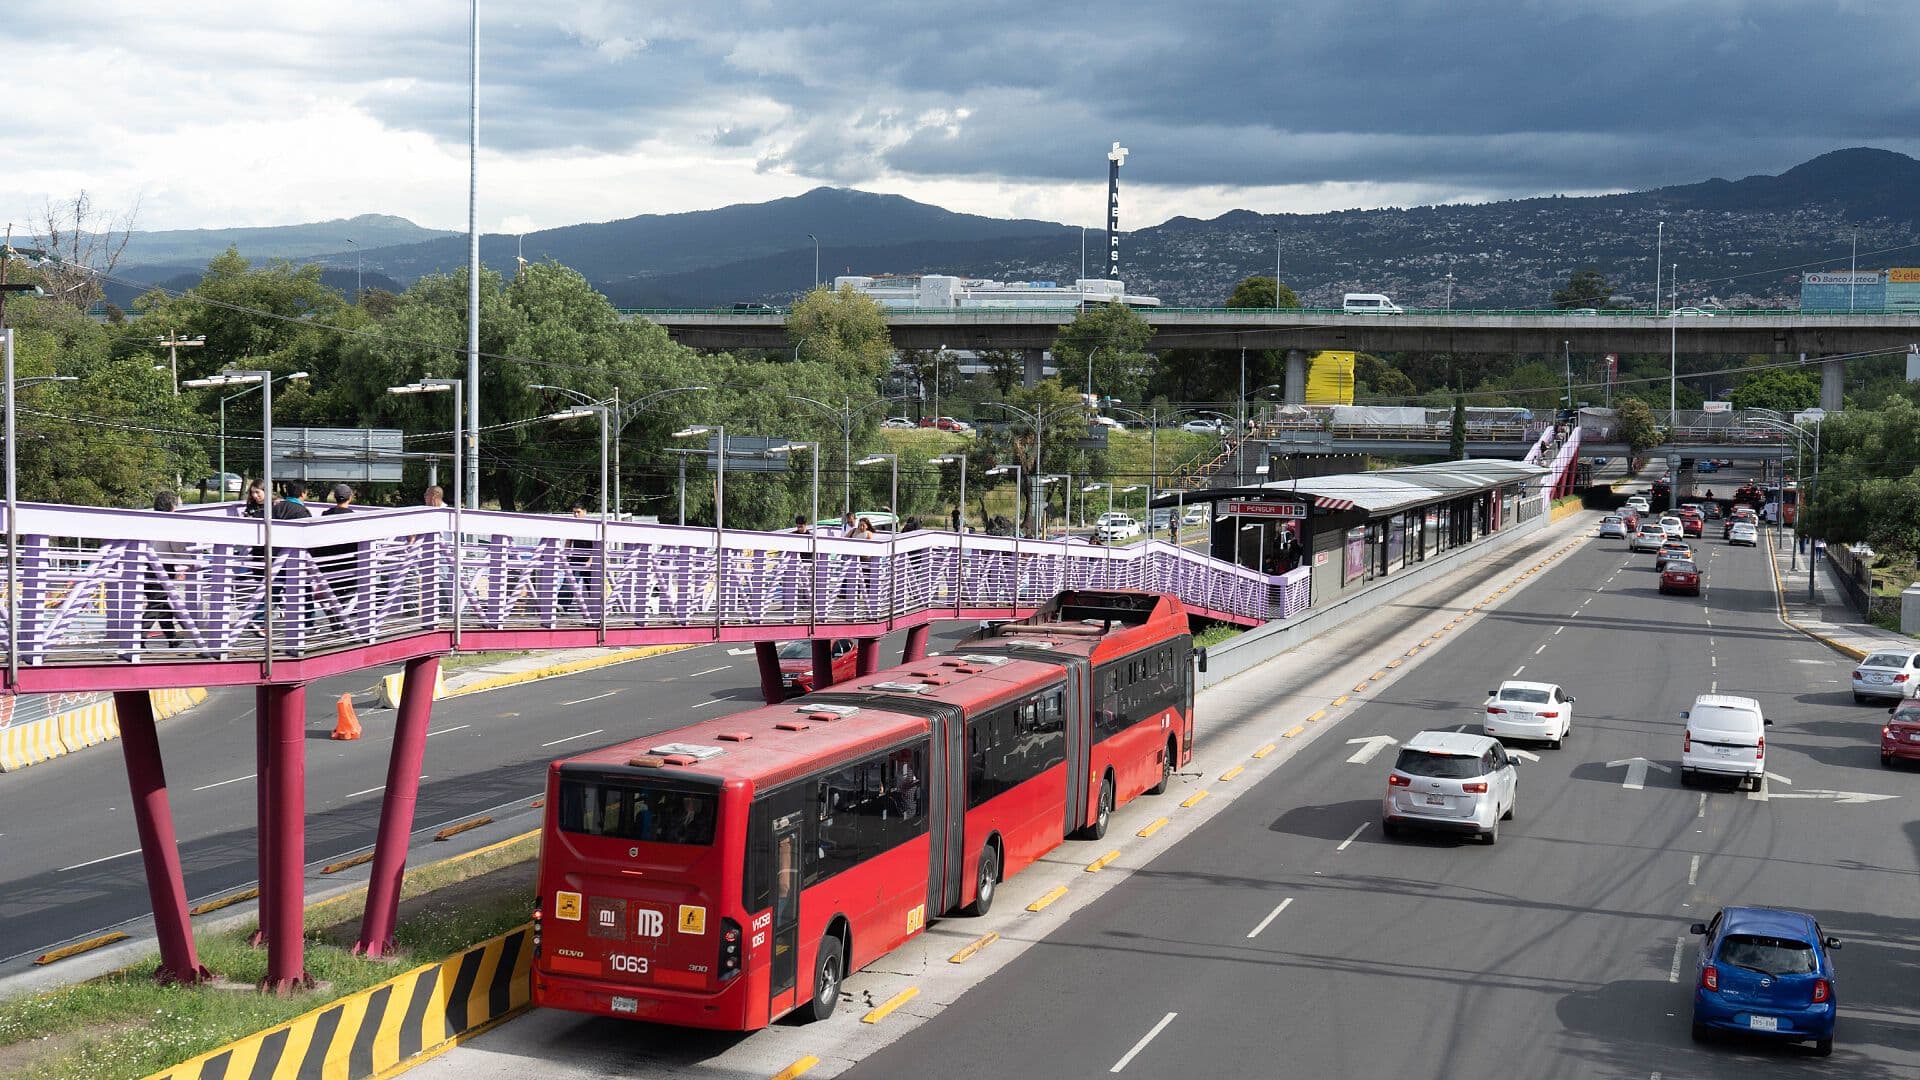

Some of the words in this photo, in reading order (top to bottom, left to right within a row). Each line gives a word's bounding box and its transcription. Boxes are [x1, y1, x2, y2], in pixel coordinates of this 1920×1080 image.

[637, 908, 664, 938] MB
[752, 931, 765, 949] 1063
[609, 953, 649, 974] 1063
